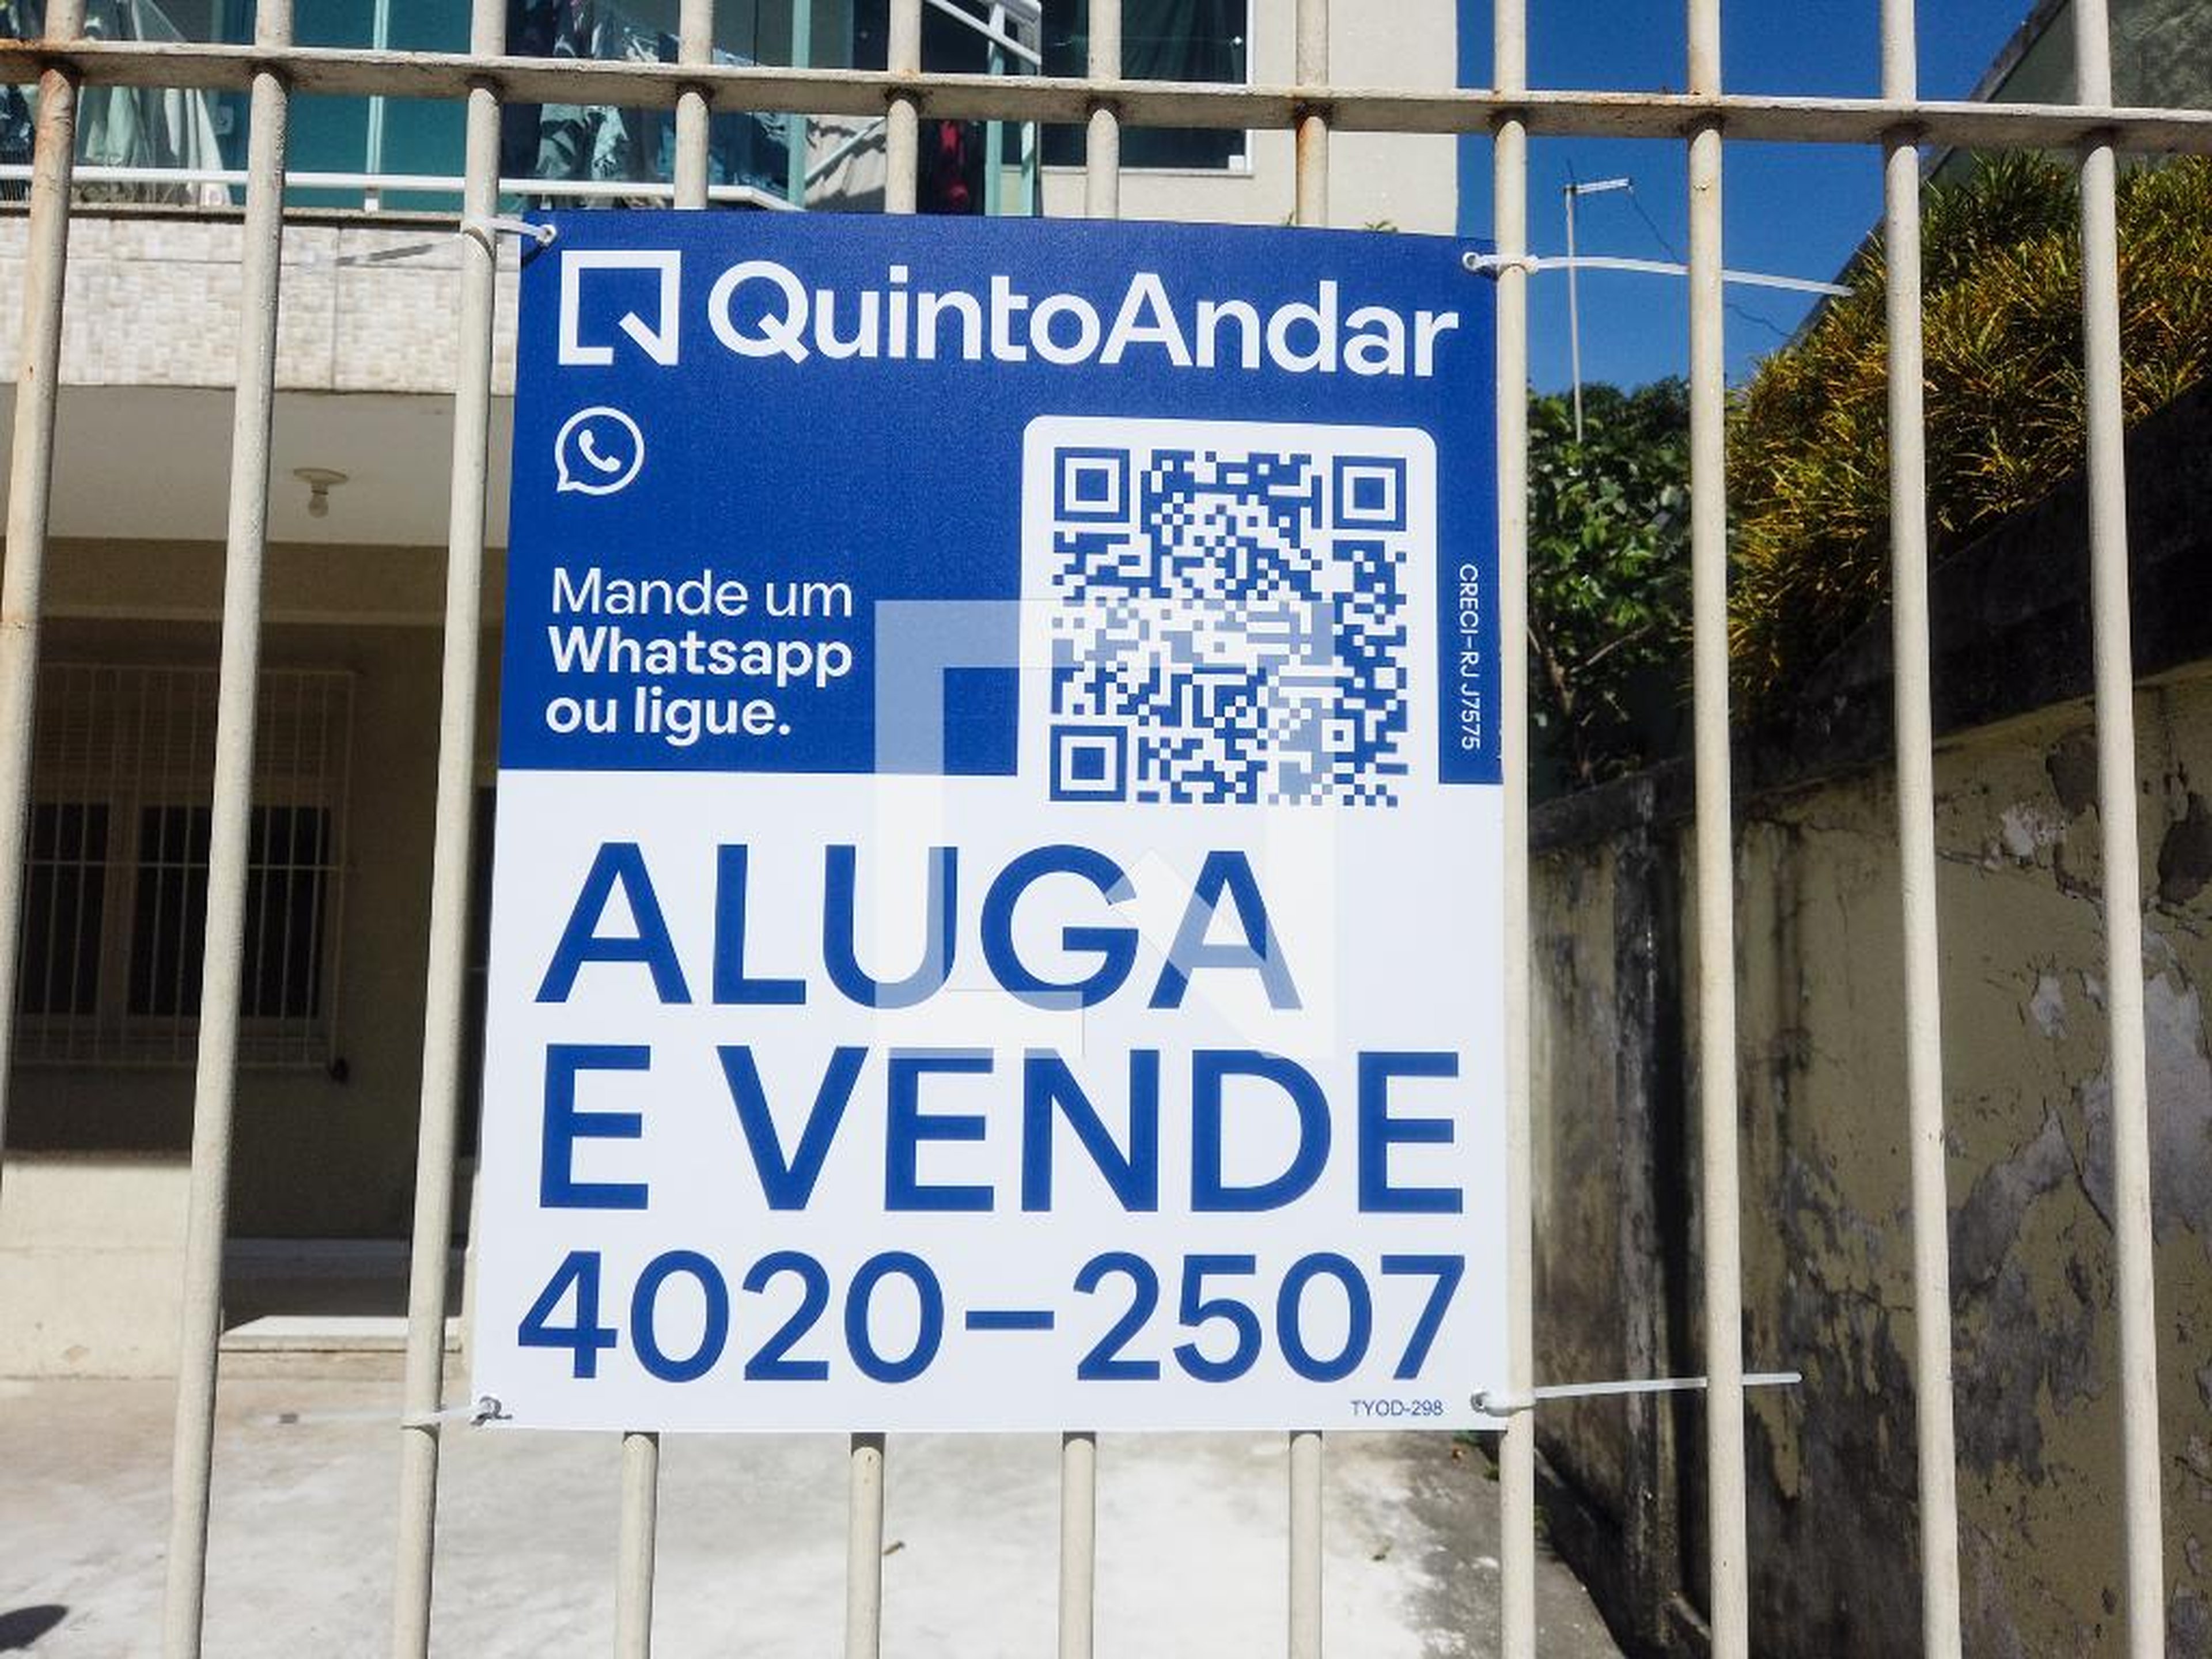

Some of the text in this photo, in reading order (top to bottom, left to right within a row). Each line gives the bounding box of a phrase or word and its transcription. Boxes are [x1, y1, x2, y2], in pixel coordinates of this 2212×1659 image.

[708, 259, 1459, 377] QuintoAndar
[553, 567, 853, 617] Mande um
[548, 626, 853, 687] Whatsapp
[1460, 563, 1480, 750] CRECI-RJ J7575
[546, 686, 790, 747] ou ligue.
[535, 842, 1303, 1010] ALUGA
[539, 1043, 1463, 1214] E VENDE
[518, 1249, 1465, 1384] 4020-2507
[1351, 1399, 1444, 1416] TYOD-298
